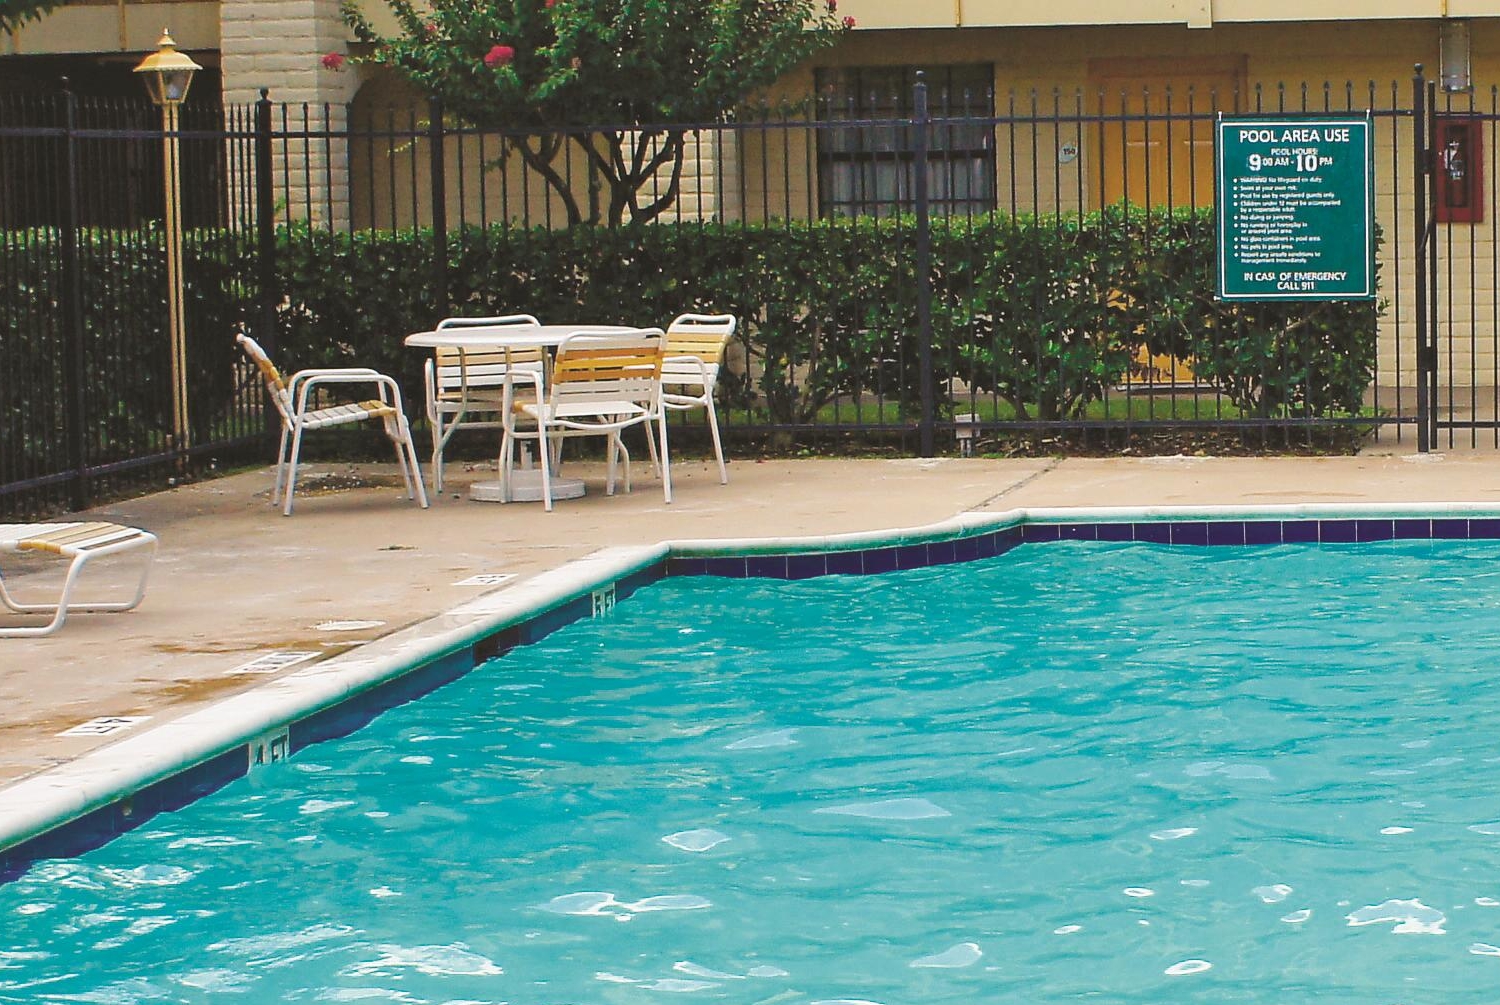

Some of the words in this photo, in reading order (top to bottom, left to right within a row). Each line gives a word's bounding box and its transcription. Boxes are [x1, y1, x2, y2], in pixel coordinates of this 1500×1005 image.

[1239, 130, 1278, 143] POOL
[1281, 129, 1320, 143] AREA
[1324, 129, 1350, 142] USE
[1271, 148, 1291, 156] POOL
[1274, 157, 1289, 166] AM
[1296, 154, 1317, 172] 10
[1319, 157, 1333, 166] PM
[1244, 272, 1254, 281] IN
[1279, 272, 1293, 281] OF
[1294, 271, 1347, 281] EMERGENCY
[1277, 281, 1300, 290] CALL
[1301, 281, 1316, 290] 911
